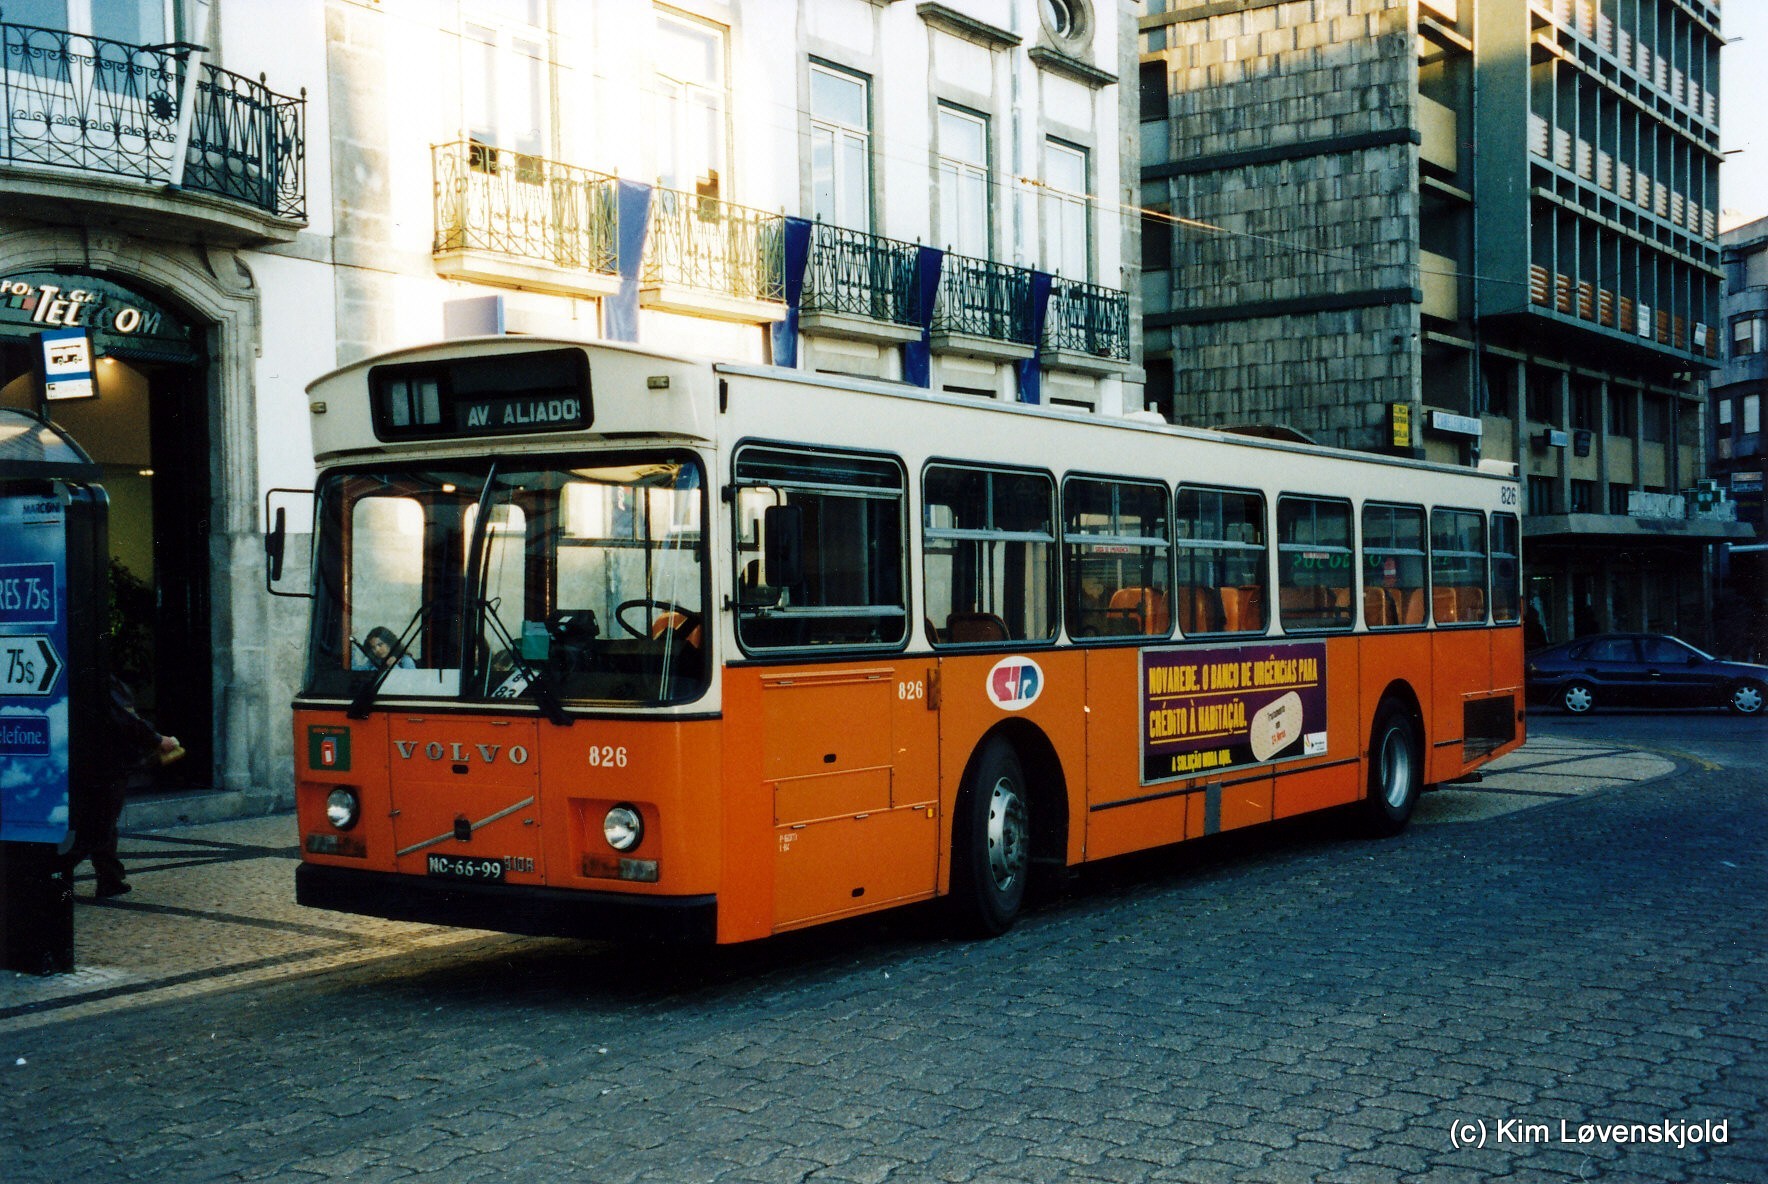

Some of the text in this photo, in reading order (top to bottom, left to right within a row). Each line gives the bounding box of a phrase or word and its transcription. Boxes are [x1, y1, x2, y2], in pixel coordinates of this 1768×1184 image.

[467, 405, 492, 426] AV.
[1501, 486, 1517, 505] 826
[1211, 662, 1239, 690] BANCO
[1241, 661, 1252, 687] DE
[1298, 657, 1318, 682] PARA
[899, 680, 923, 700] 826
[394, 740, 528, 764] VOLVO
[589, 745, 628, 767] 826
[429, 857, 502, 878] NC-66-99
